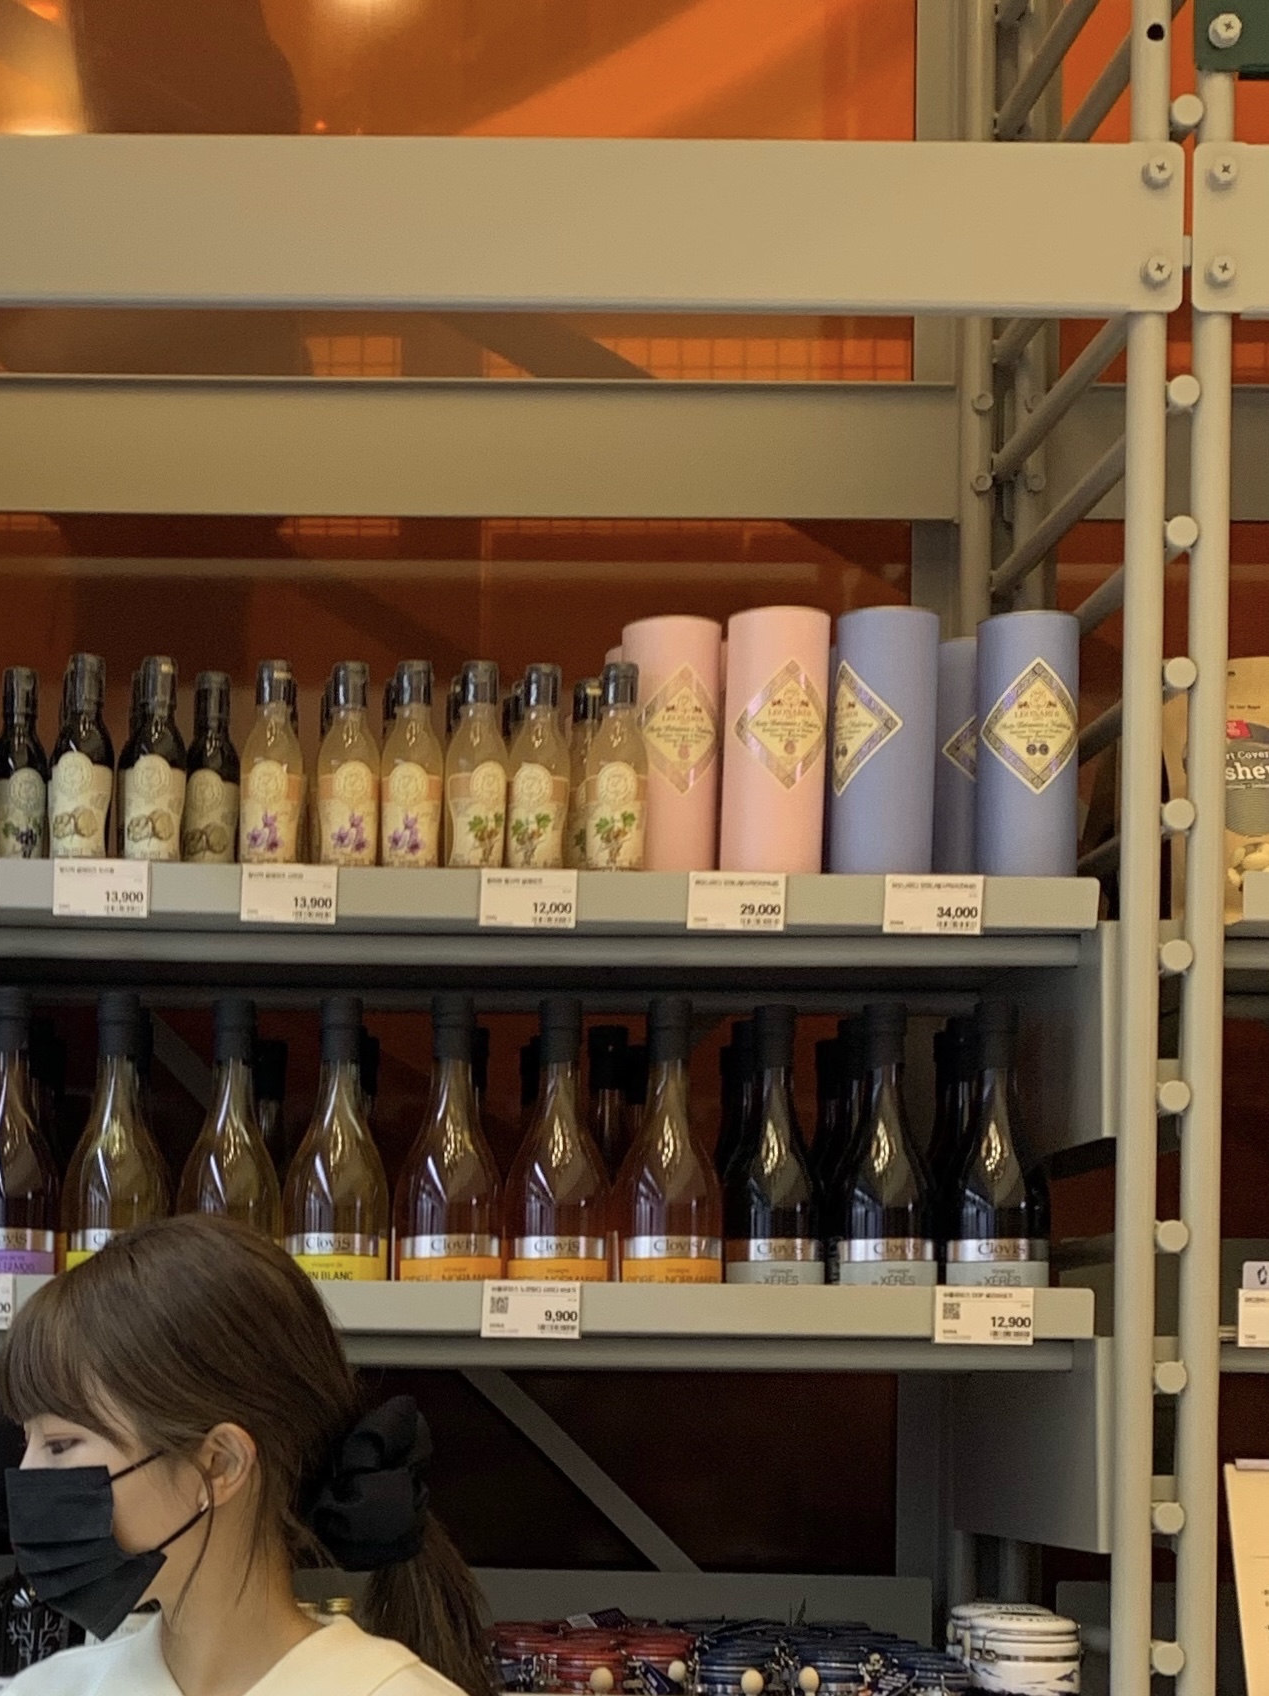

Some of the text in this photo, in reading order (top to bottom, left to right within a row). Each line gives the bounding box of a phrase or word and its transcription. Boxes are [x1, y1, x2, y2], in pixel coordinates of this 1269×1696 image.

[105, 891, 144, 903] 13,900
[293, 896, 332, 910] 13,900
[532, 901, 572, 915] 12,000
[740, 903, 781, 917] 29,000
[937, 906, 979, 919] 34,000
[305, 1235, 351, 1250] Clovis
[431, 1236, 477, 1251] Clovis
[534, 1237, 580, 1252] Clovis
[653, 1237, 701, 1252] Clovis
[977, 1240, 1025, 1256] Clovis
[320, 1271, 353, 1281] BLANC
[544, 1310, 578, 1323] 9,900
[990, 1315, 1032, 1329] 12,900
